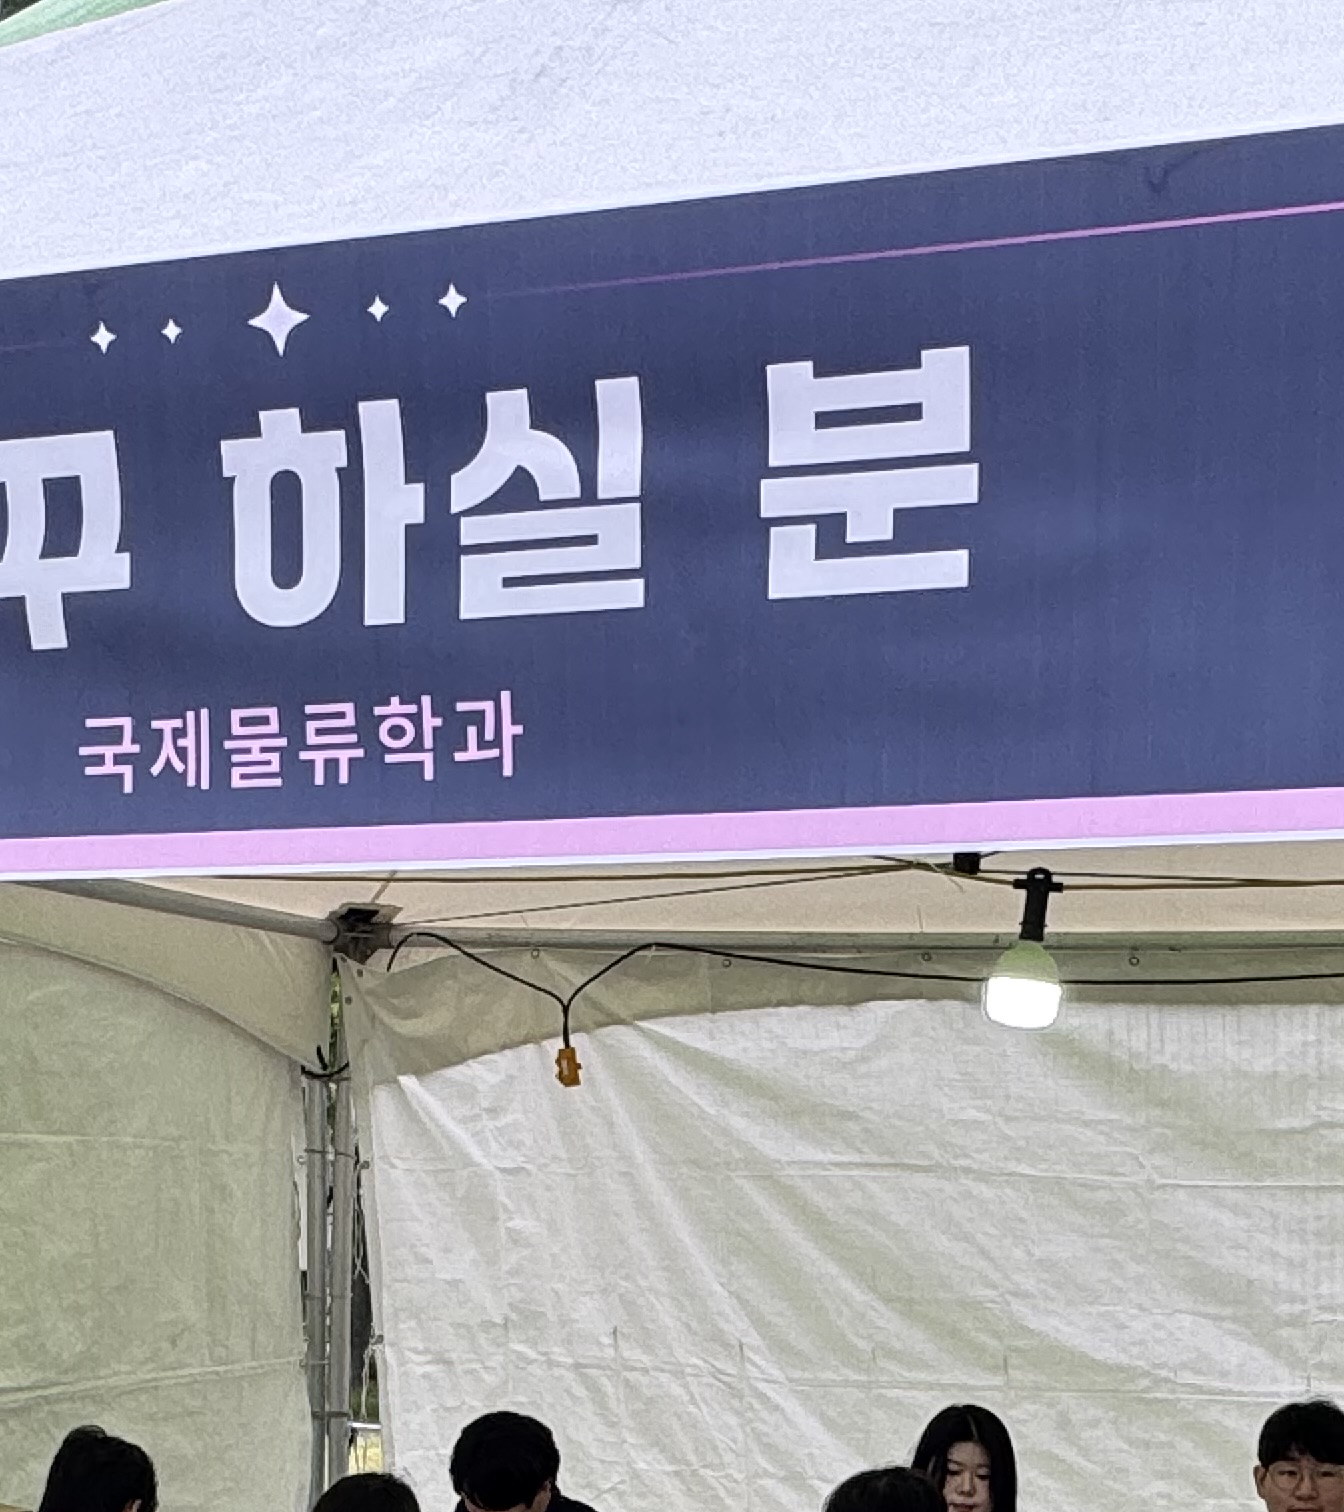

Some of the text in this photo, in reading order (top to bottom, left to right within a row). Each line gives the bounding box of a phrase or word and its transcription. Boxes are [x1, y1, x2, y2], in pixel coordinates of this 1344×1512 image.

[220, 375, 645, 628] 하실
[760, 345, 980, 600] 분
[78, 690, 524, 794] 국제물류학과
